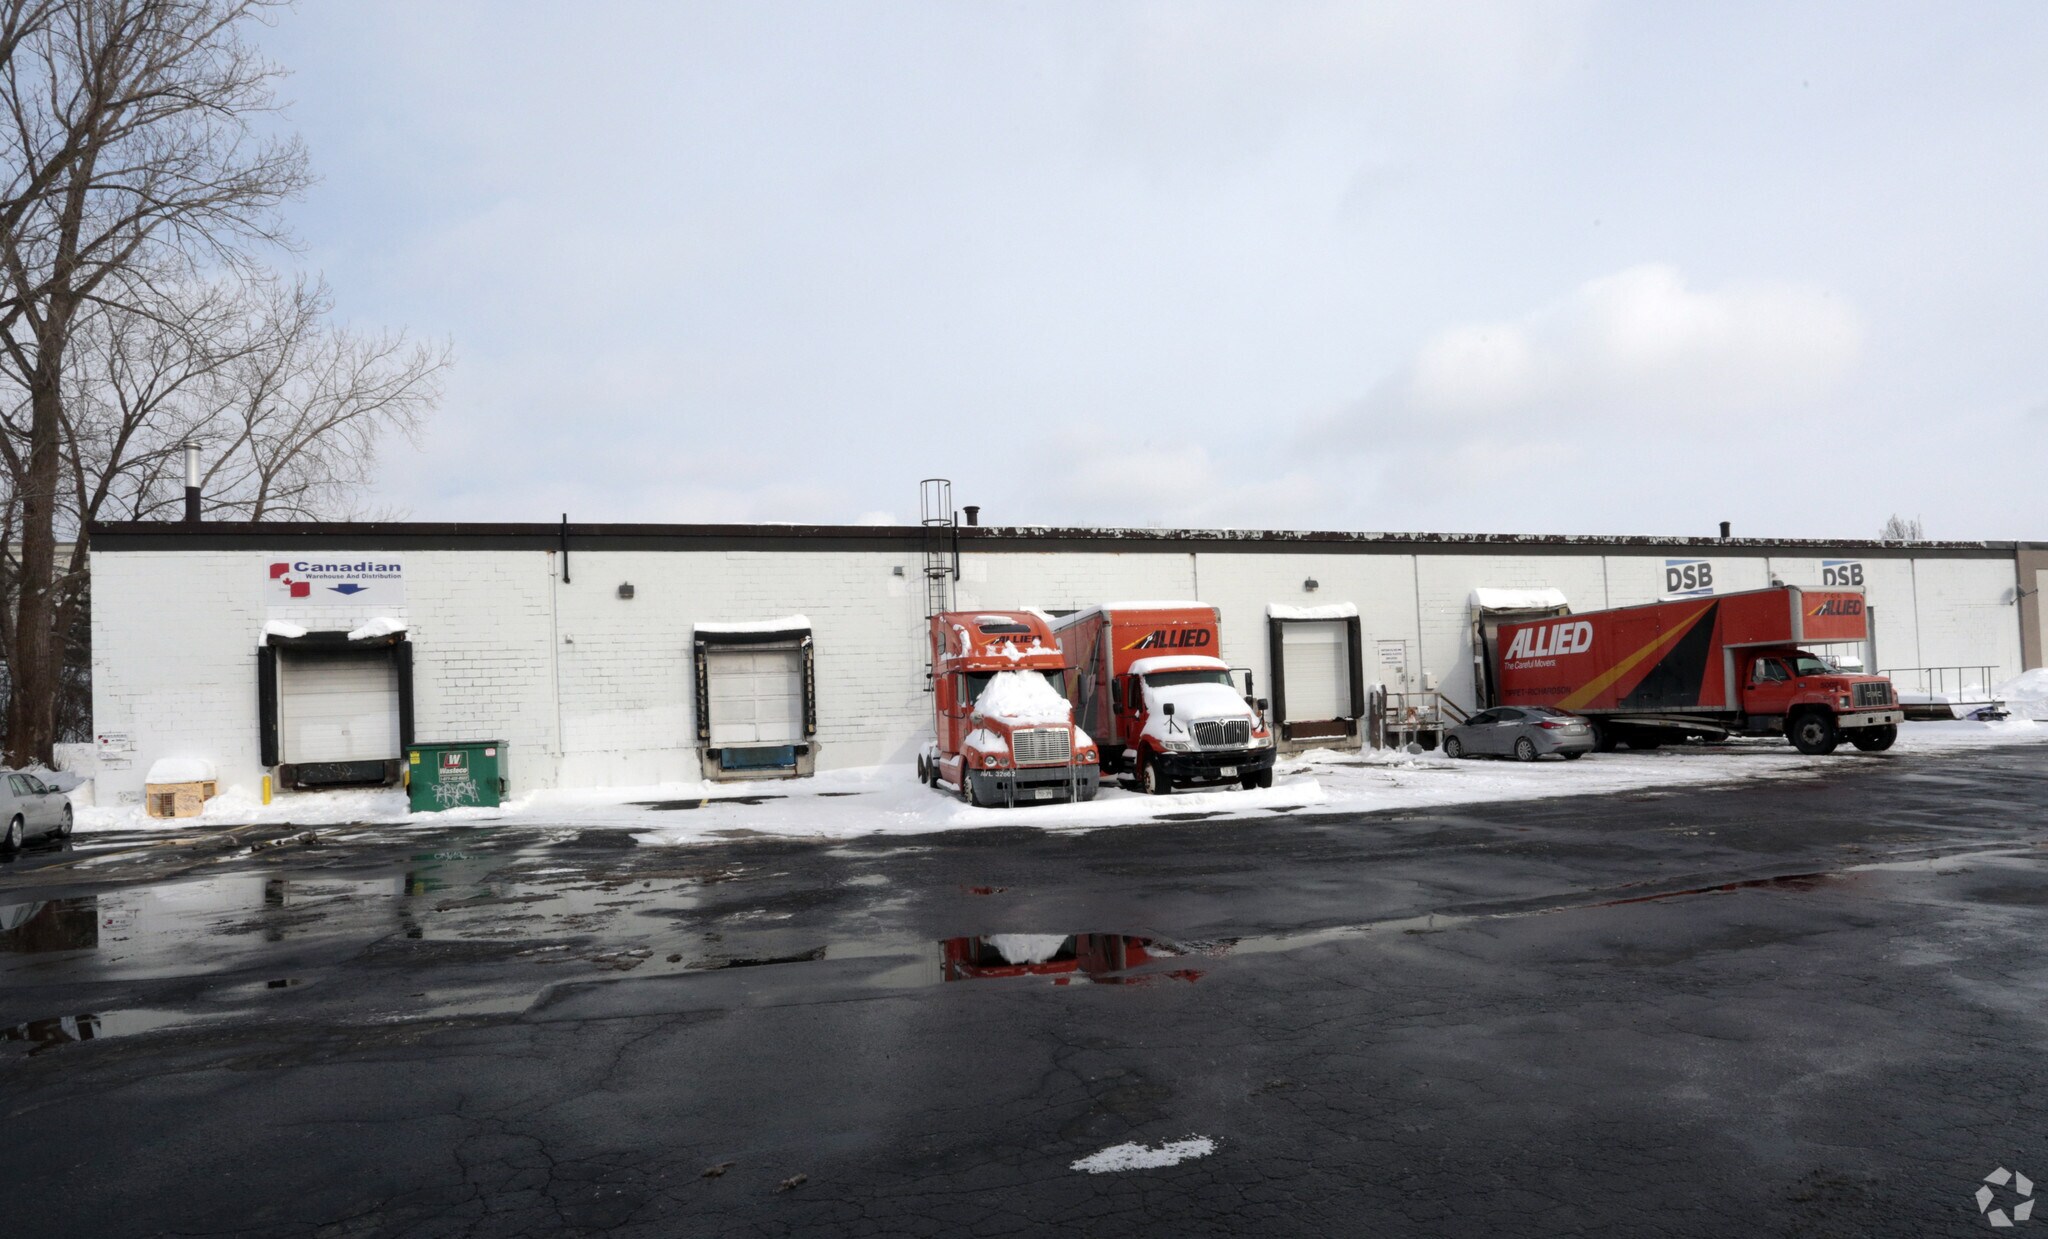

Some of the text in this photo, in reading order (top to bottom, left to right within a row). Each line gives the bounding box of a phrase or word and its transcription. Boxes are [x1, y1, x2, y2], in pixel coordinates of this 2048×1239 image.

[294, 561, 401, 572] Canadian
[1666, 562, 1713, 592] DSB
[1823, 563, 1864, 586] DSB
[1815, 599, 1862, 616] ALLIED
[1132, 628, 1211, 650] ALLIED
[1504, 621, 1593, 660] ALLIED
[1504, 658, 1556, 670] The Careful Movers
